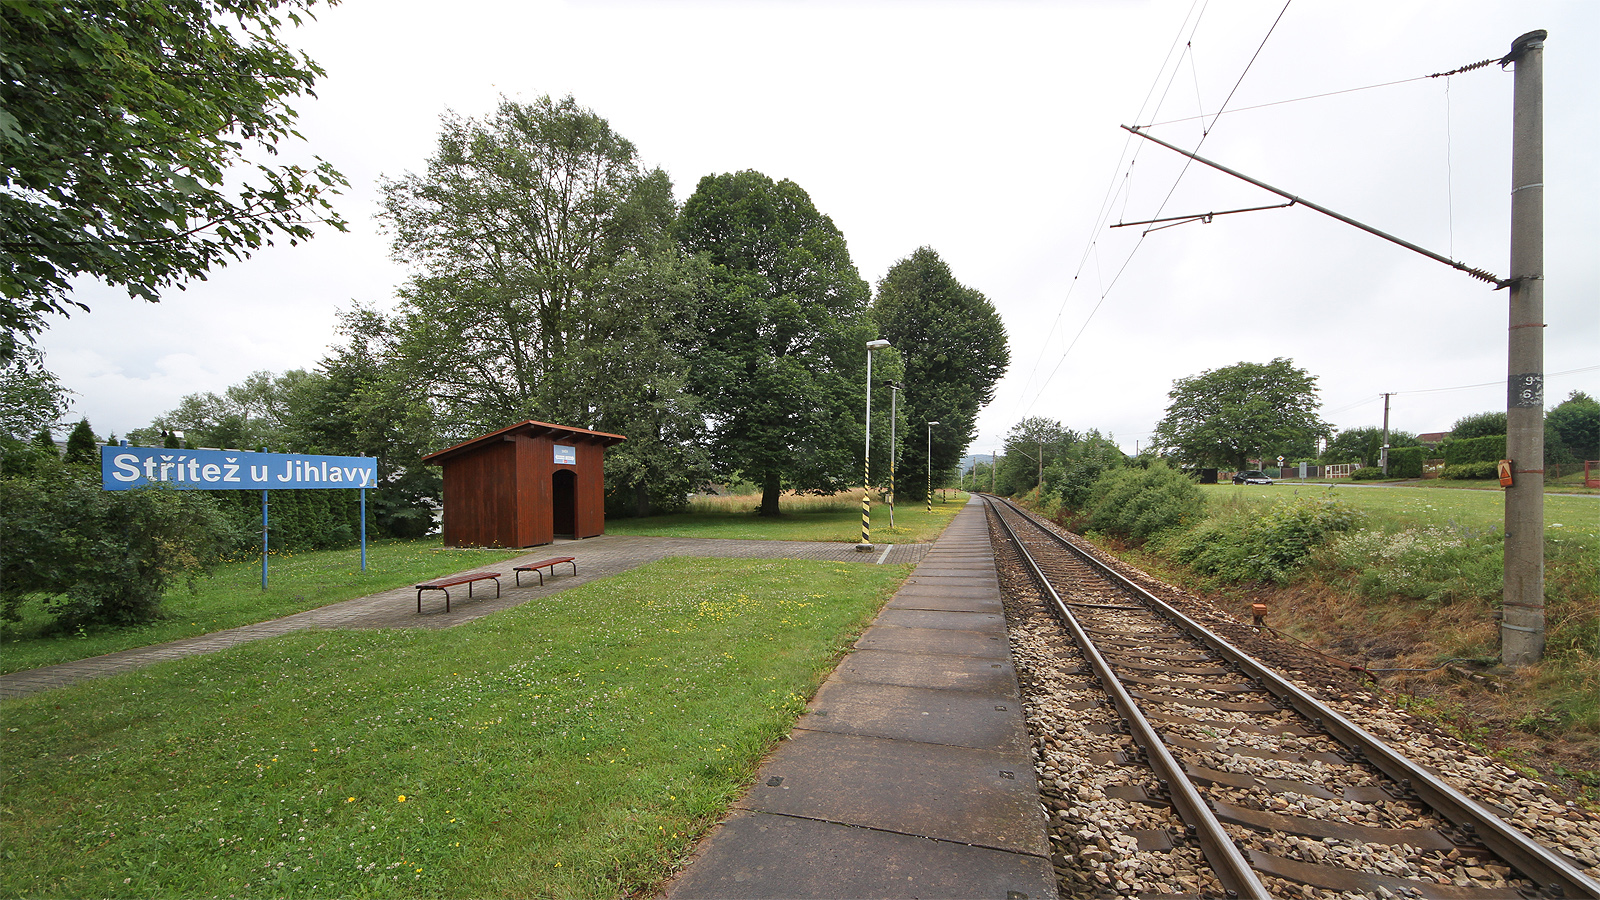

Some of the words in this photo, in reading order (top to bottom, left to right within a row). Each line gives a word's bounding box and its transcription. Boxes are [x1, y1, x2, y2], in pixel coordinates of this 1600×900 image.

[1525, 376, 1534, 386] 9
[1523, 389, 1532, 399] 6
[112, 453, 241, 482] Střítež
[250, 465, 268, 482] u
[277, 460, 372, 487] Jihlavy
